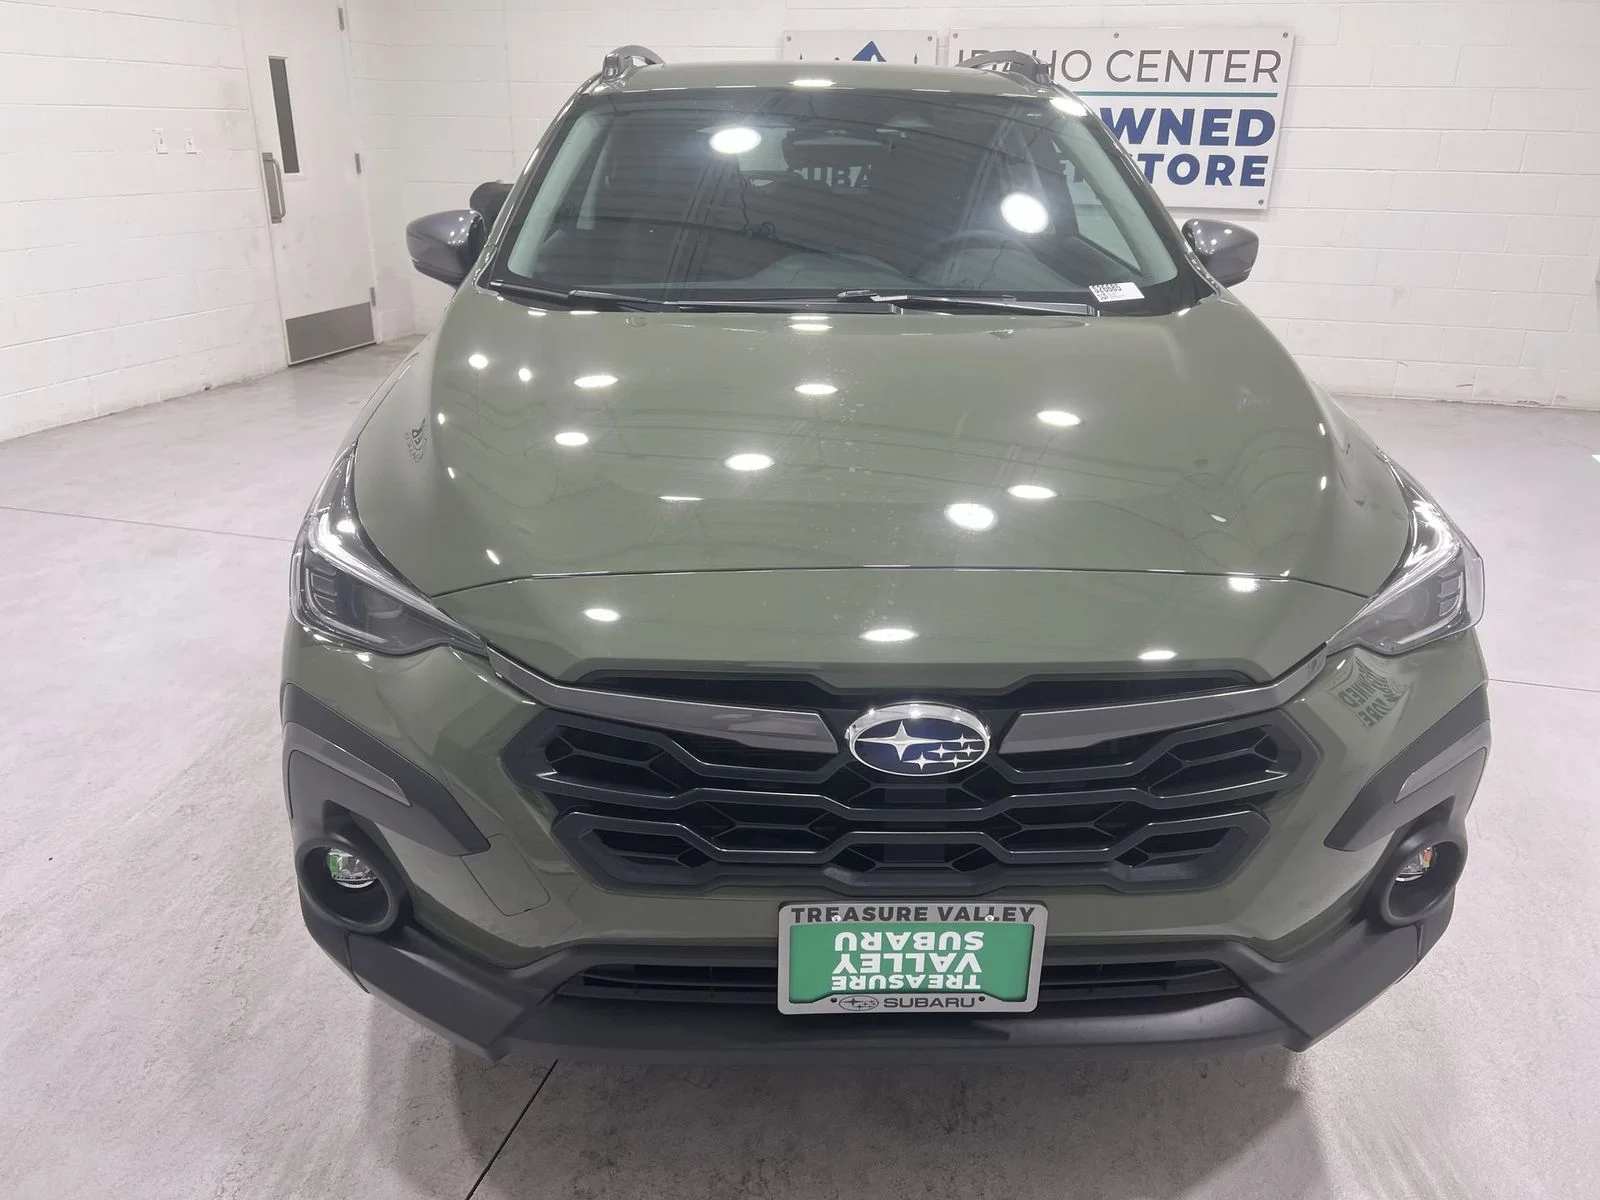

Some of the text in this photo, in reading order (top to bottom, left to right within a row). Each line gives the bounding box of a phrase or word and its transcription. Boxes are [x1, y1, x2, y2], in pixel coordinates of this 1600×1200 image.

[959, 49, 1282, 83] IHO CENTER
[1100, 107, 1276, 147] WNED
[1130, 153, 1269, 187] TORE
[791, 906, 1035, 923] TREASURE VALLEY
[834, 930, 985, 952] SUBARU
[832, 952, 982, 974] VALLEY
[832, 974, 981, 991] TREASURE
[883, 997, 976, 1008] SUBARU
